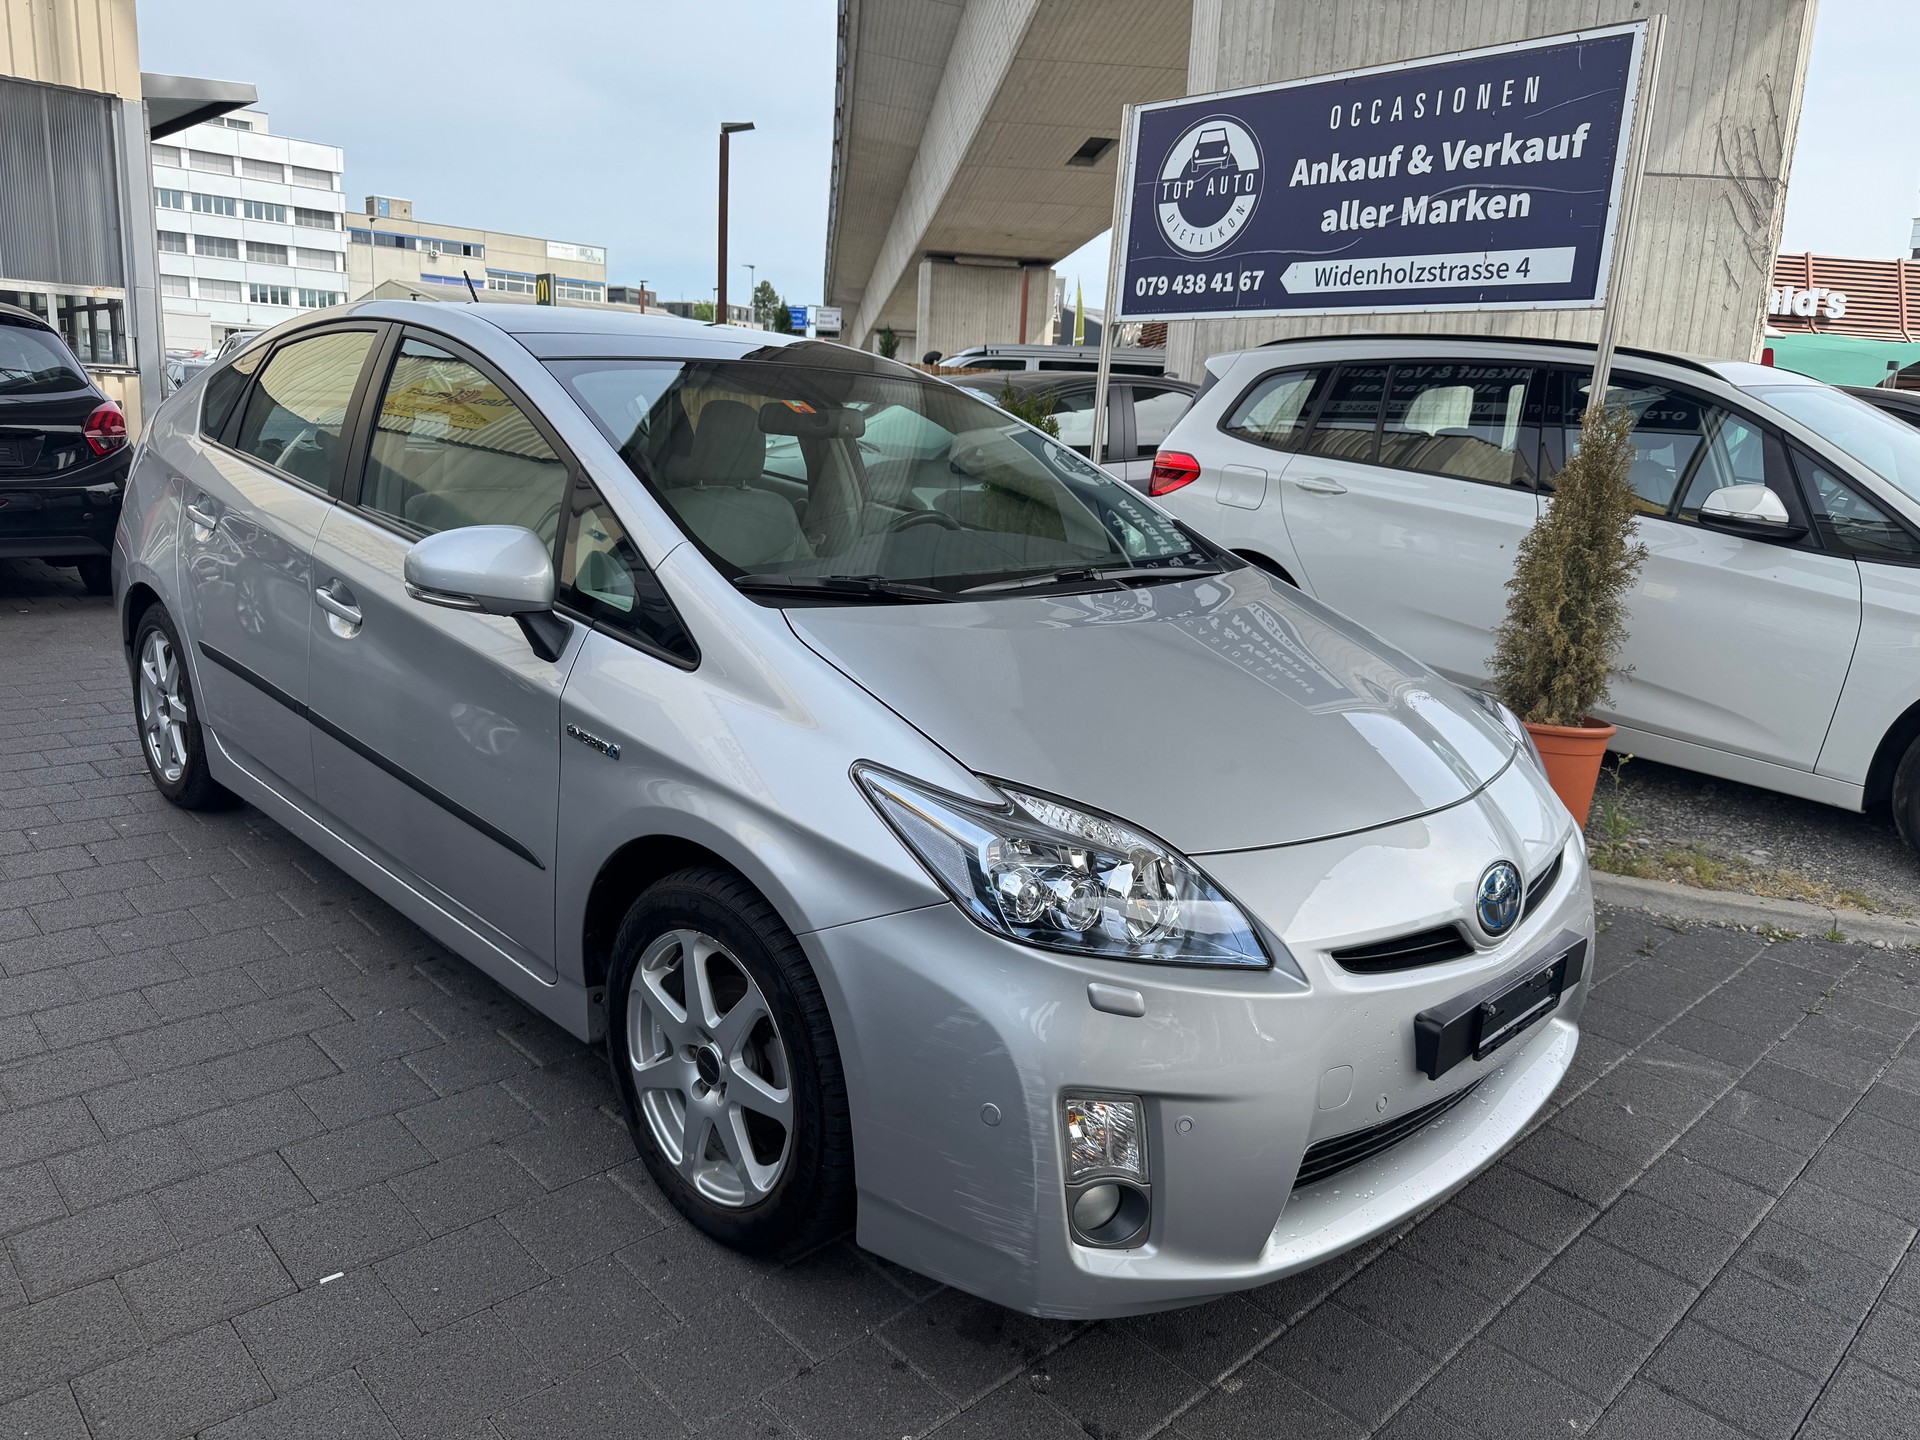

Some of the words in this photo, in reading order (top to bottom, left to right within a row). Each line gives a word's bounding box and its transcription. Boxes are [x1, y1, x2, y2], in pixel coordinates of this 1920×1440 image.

[1329, 75, 1541, 131] OCCASIONEN
[1288, 145, 1405, 188] Ankauf
[1406, 144, 1434, 176] &
[1442, 122, 1592, 172] Verkauf
[1161, 179, 1195, 201] TOP
[1205, 172, 1255, 197] AUTO
[1166, 204, 1246, 246] DIETLIKON
[1320, 199, 1395, 233] aller
[1399, 189, 1532, 227] Marken
[1135, 275, 1169, 298] 079
[1171, 273, 1207, 296] 438
[1209, 271, 1234, 293] 41
[1238, 270, 1265, 292] 67
[1314, 260, 1510, 288] Widenholzstrasse
[1515, 256, 1531, 278] 4
